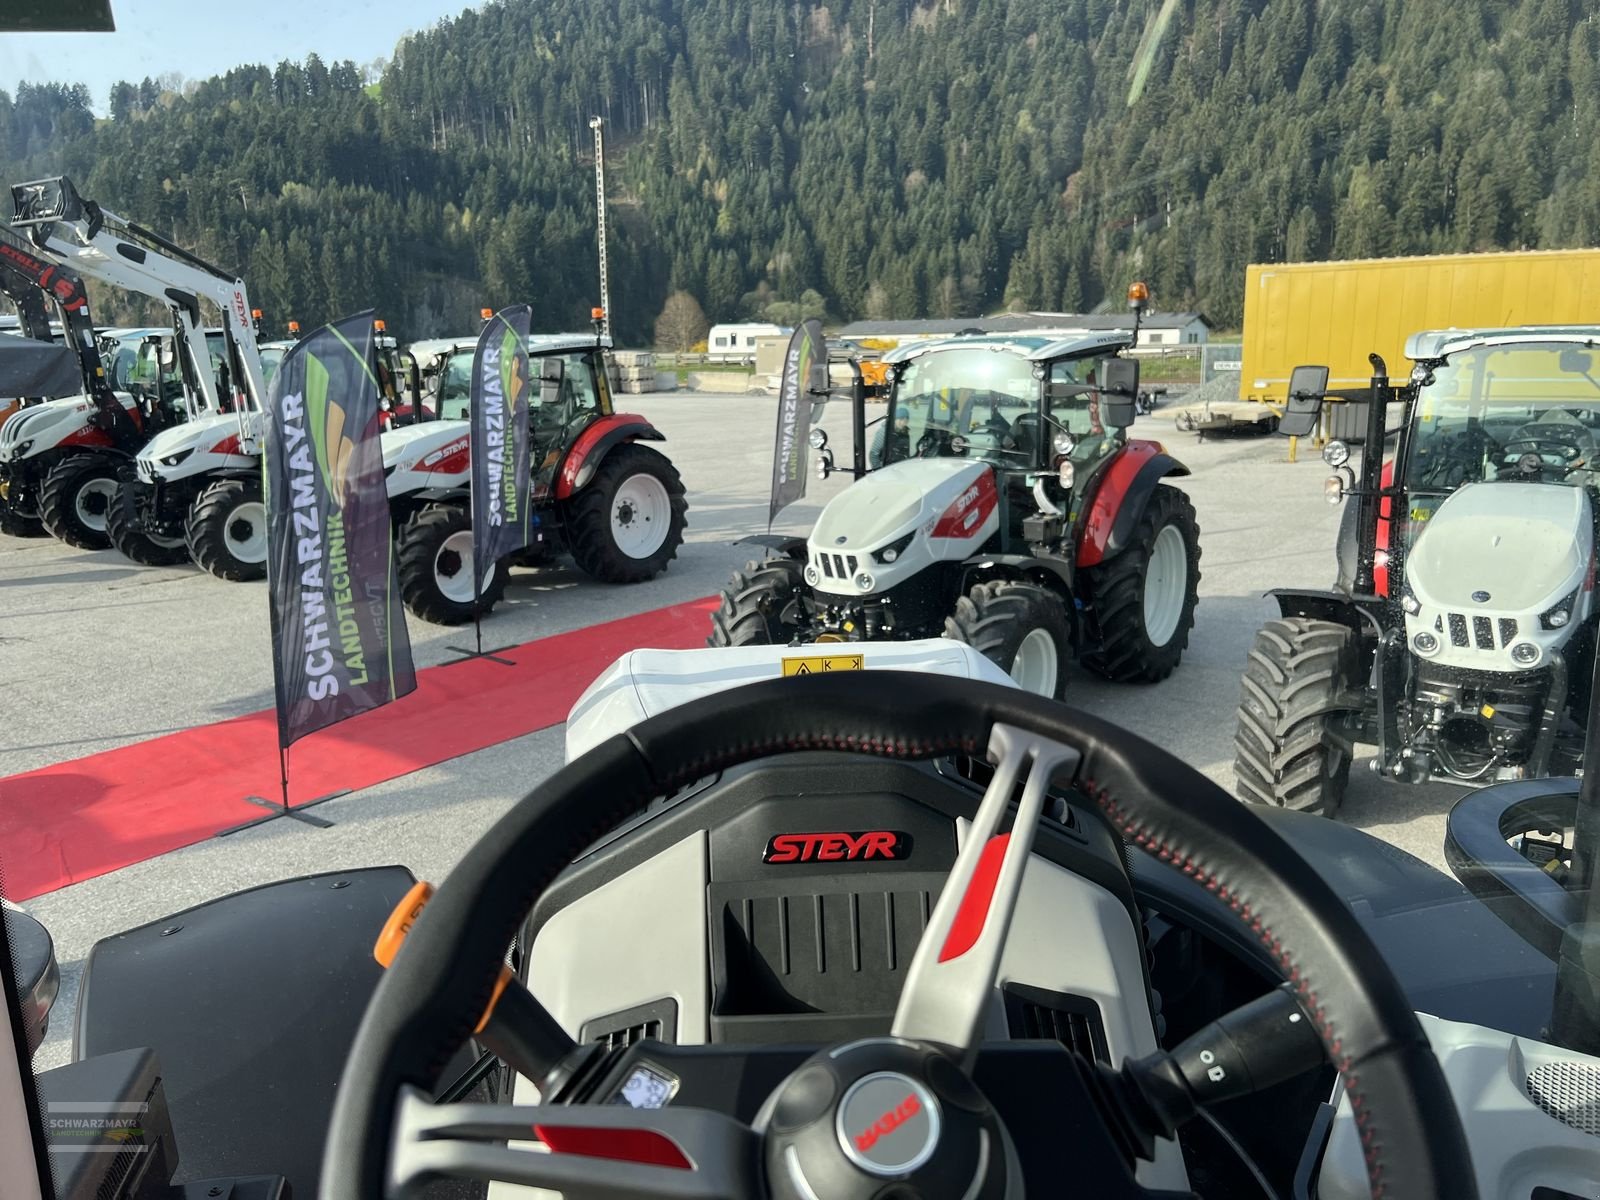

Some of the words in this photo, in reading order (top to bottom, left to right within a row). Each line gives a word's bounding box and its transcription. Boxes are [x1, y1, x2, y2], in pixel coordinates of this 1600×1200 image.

[234, 291, 249, 328] STEYR
[442, 440, 468, 458] STEYR
[483, 347, 504, 527] SCHWARZMAYR
[957, 486, 979, 513] STEYR
[282, 391, 340, 701] SCHWARZMAYR
[327, 509, 369, 687] LANDTECHNIK
[769, 831, 897, 862] STEYR
[854, 1092, 921, 1153] STEYR
